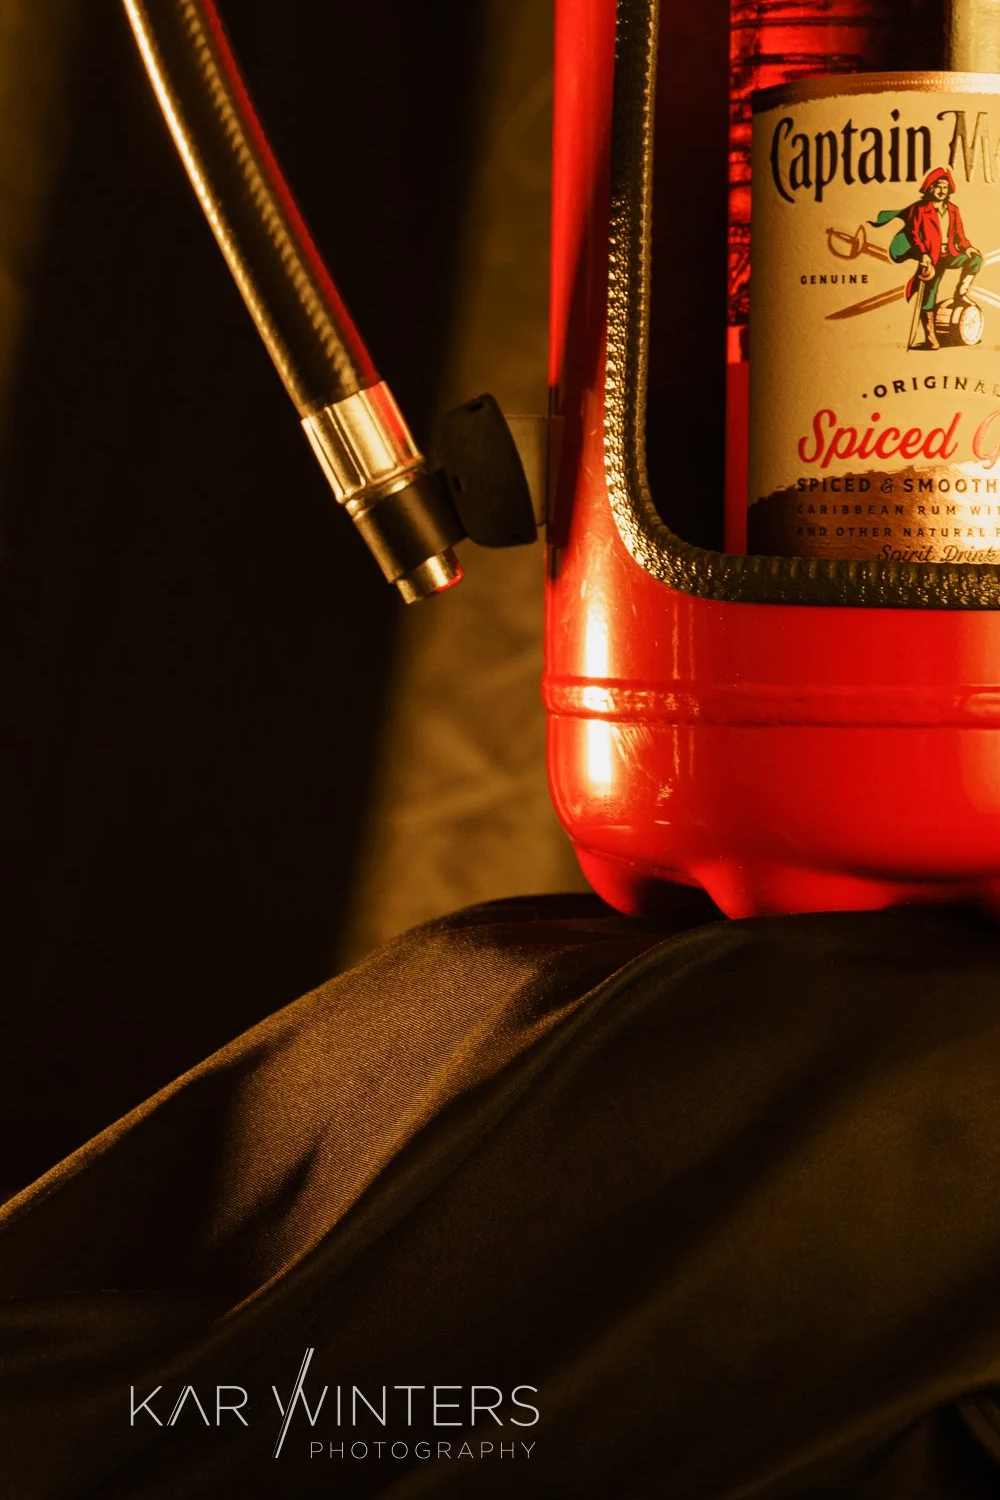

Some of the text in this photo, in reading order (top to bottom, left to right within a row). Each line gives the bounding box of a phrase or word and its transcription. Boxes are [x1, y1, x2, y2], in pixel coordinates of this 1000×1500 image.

[769, 108, 932, 204] Captain
[800, 274, 869, 285] GENUINE
[796, 408, 963, 469] Spiced
[796, 477, 871, 493] SPICED
[880, 477, 894, 494] &
[903, 477, 998, 493] SMOOTH
[796, 504, 905, 515] CARIBBEAN
[917, 505, 957, 516] RUM
[796, 526, 828, 537] AND
[835, 526, 893, 538] OTHER
[903, 527, 987, 538] NATURAL
[876, 543, 998, 562] Spirit Drink
